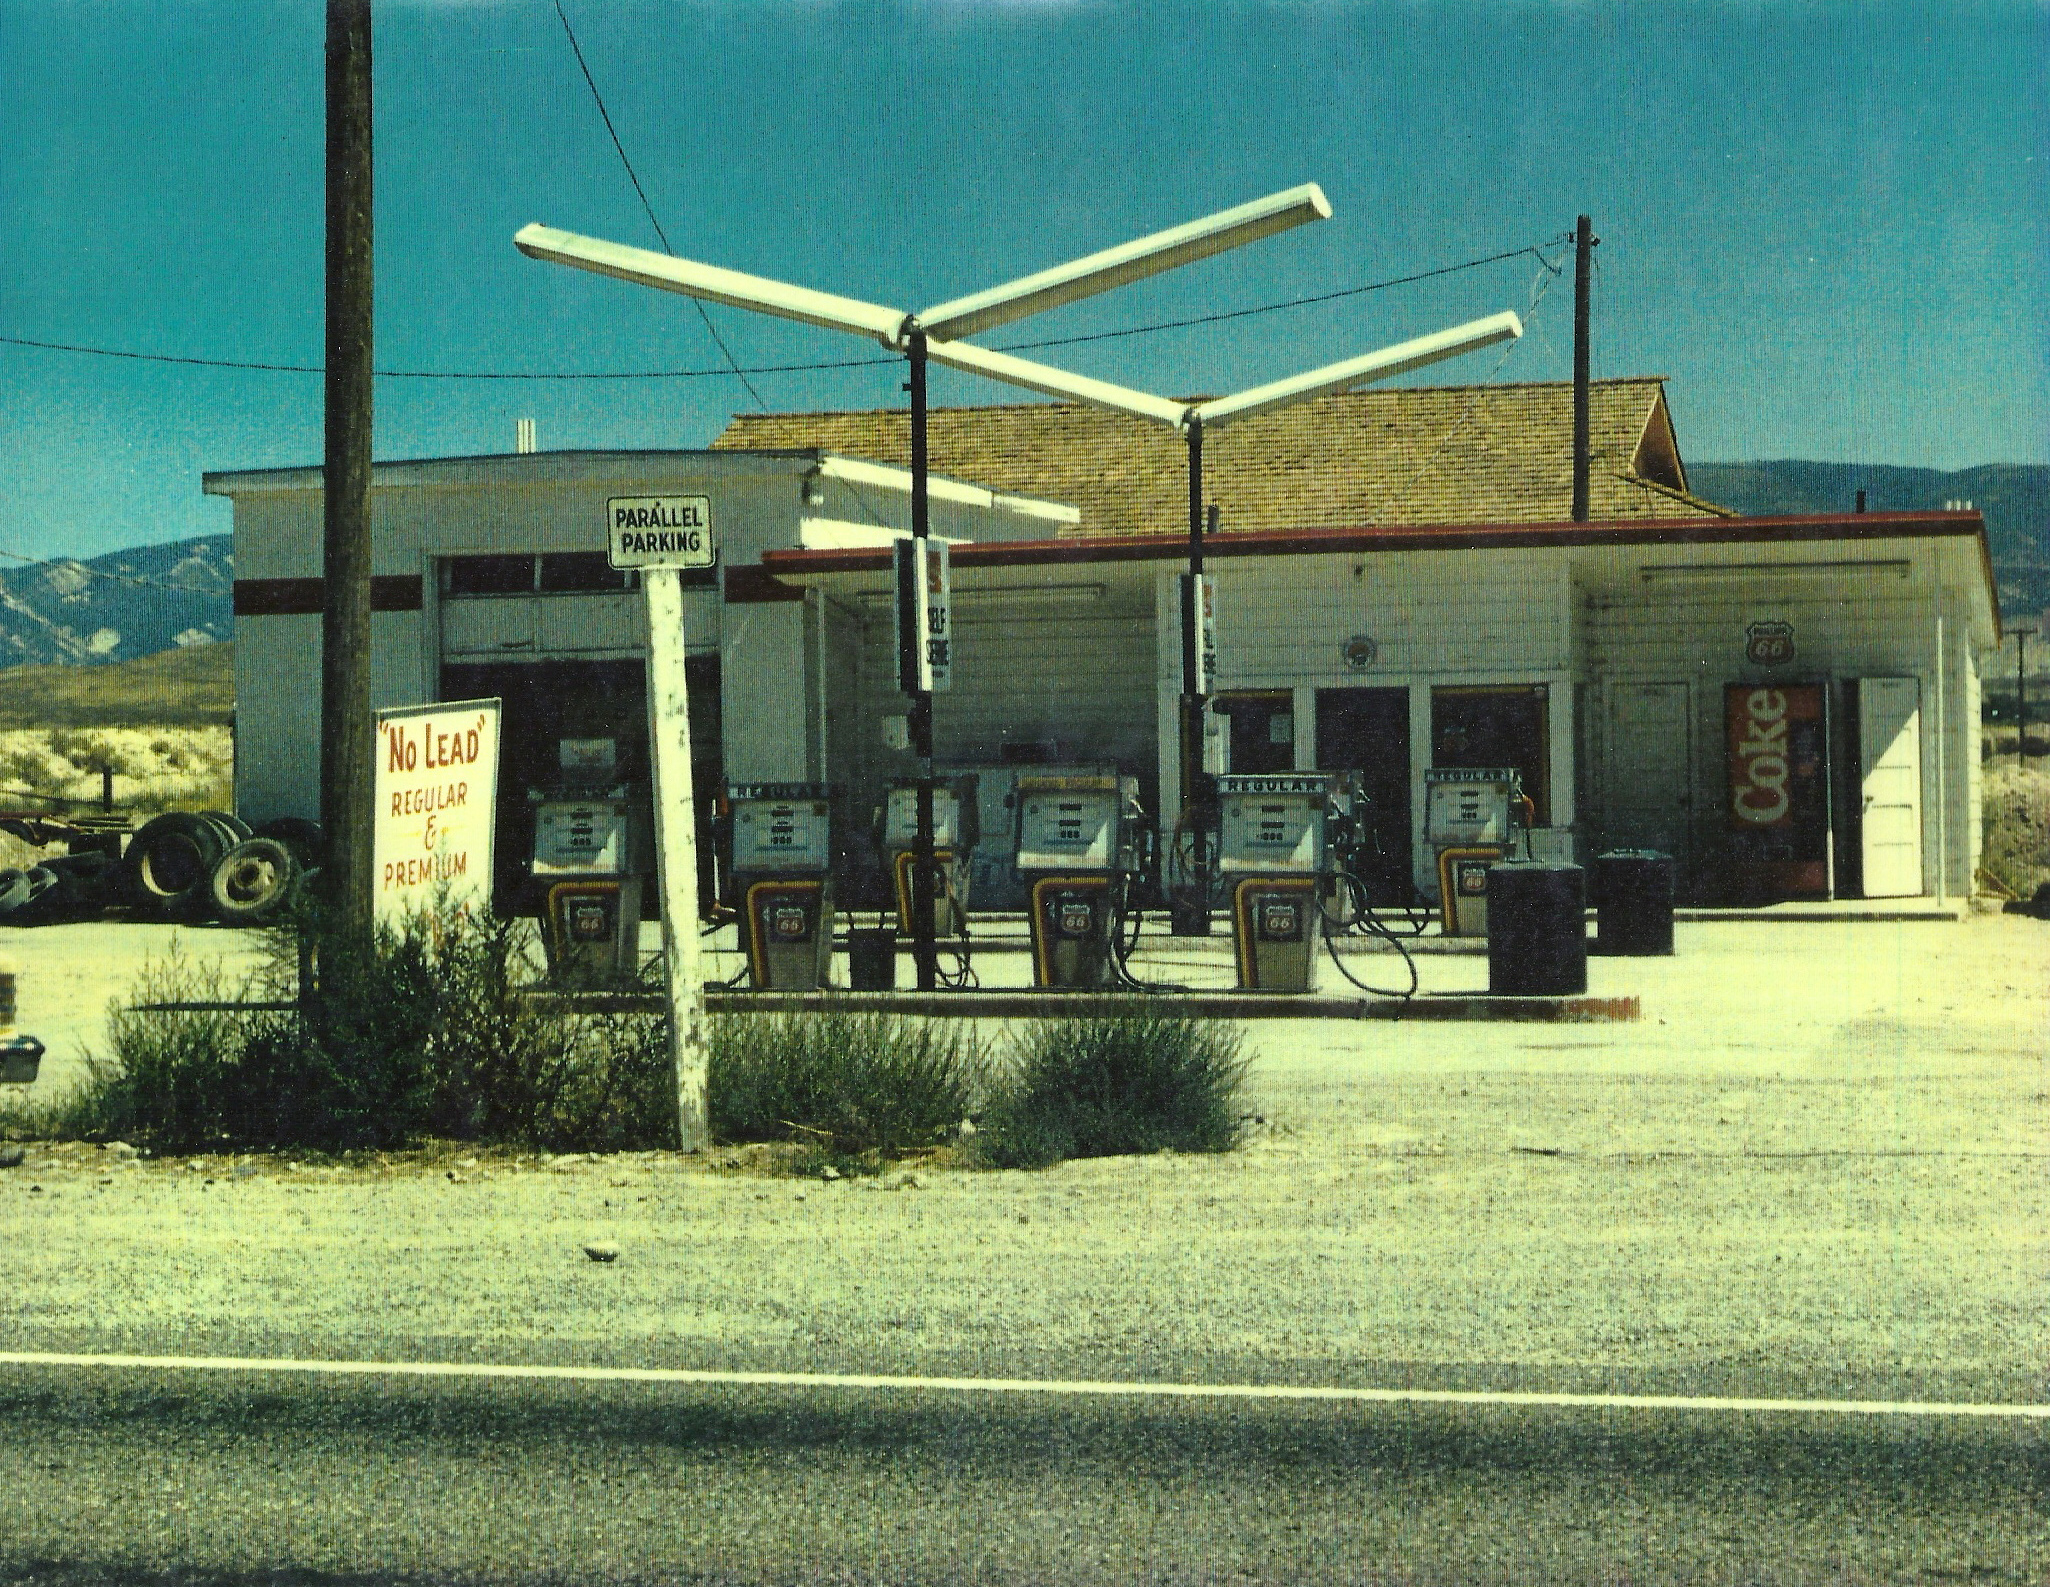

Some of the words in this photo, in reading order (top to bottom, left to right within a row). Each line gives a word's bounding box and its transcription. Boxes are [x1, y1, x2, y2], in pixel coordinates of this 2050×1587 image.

[615, 507, 703, 528] PARALLEL
[621, 531, 700, 553] PARKING
[1755, 641, 1784, 656] 66
[1733, 688, 1789, 823] Coke
[1228, 779, 1317, 791] REGULAR
[391, 781, 468, 817] REGULAR
[384, 851, 467, 891] PREMIUM
[780, 919, 800, 930] 66
[1066, 916, 1085, 927] 66
[1270, 916, 1290, 928] 66
